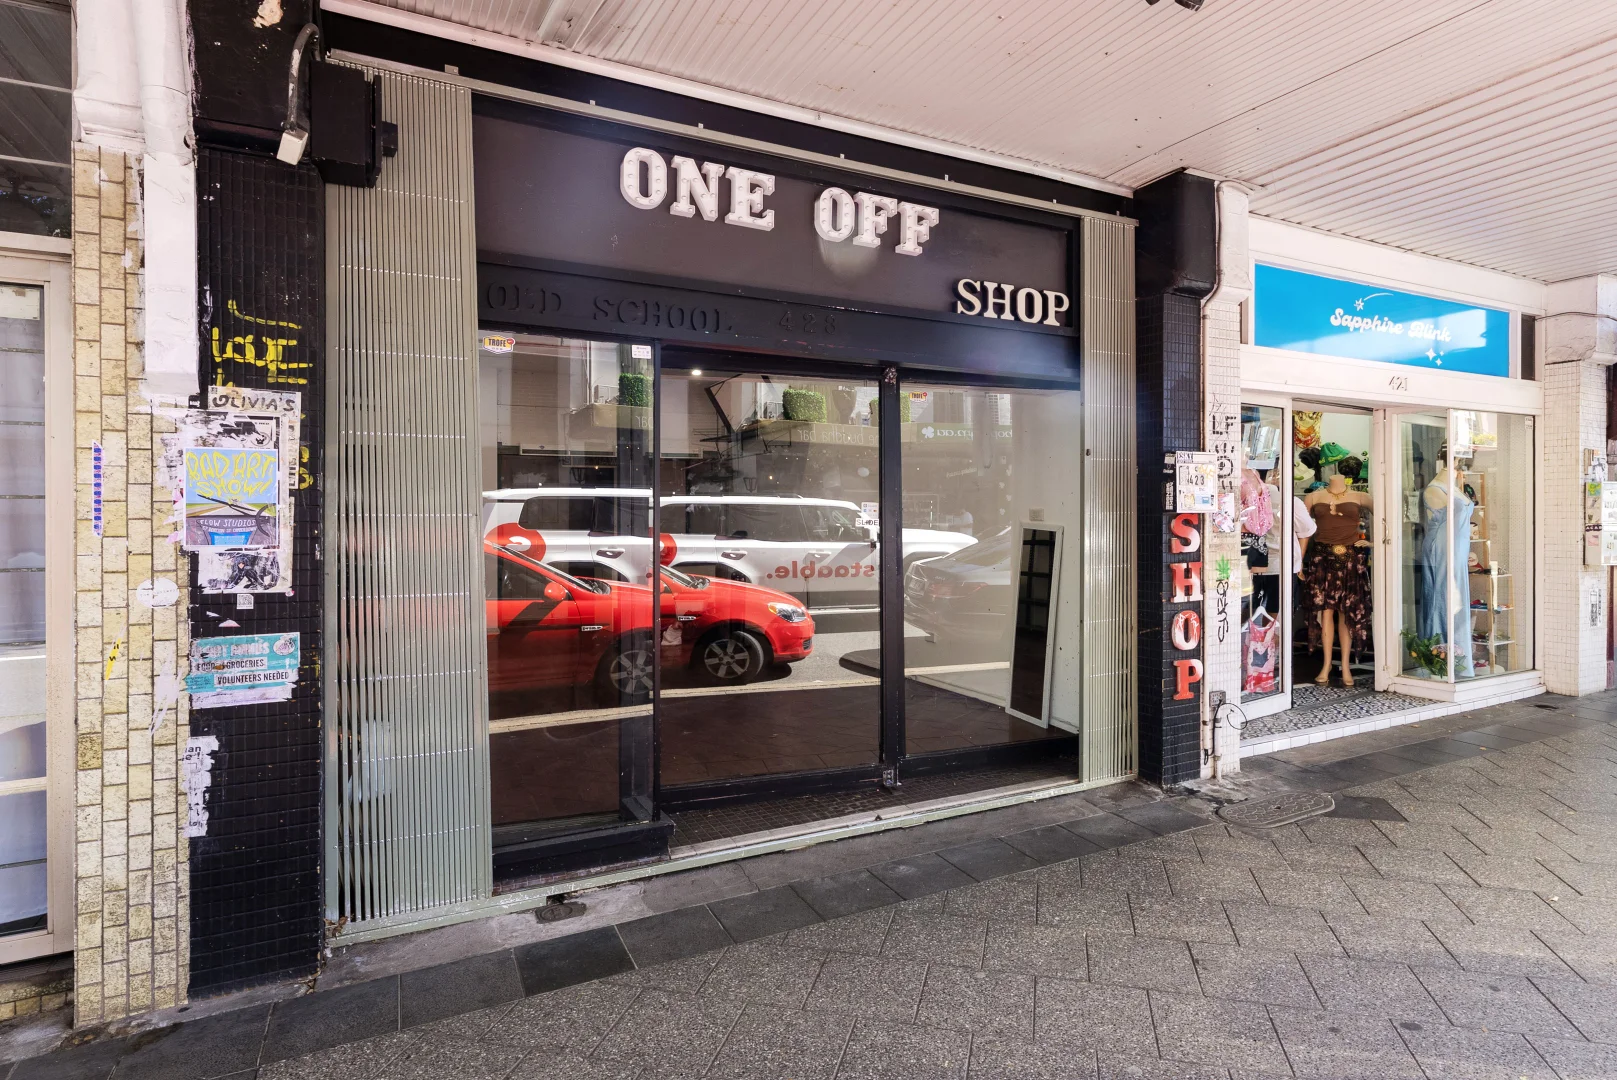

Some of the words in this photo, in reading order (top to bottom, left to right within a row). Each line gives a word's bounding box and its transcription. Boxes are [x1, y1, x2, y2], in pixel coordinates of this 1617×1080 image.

[620, 146, 776, 232] ONE
[813, 186, 940, 256] OFF
[486, 280, 562, 315] OLD
[593, 295, 732, 333] SCHOOL
[778, 310, 837, 335] 428
[956, 278, 1070, 327] SHOP
[1330, 308, 1405, 335] Sapphire
[1408, 321, 1452, 342] Blink
[212, 394, 296, 412] OLIVIA'S
[223, 518, 256, 527] STUDIOS
[1170, 513, 1204, 700] SHOP
[217, 673, 262, 685] VOLUNTEERS
[263, 671, 289, 681] NEEDED
[226, 659, 265, 669] GROCERIES
